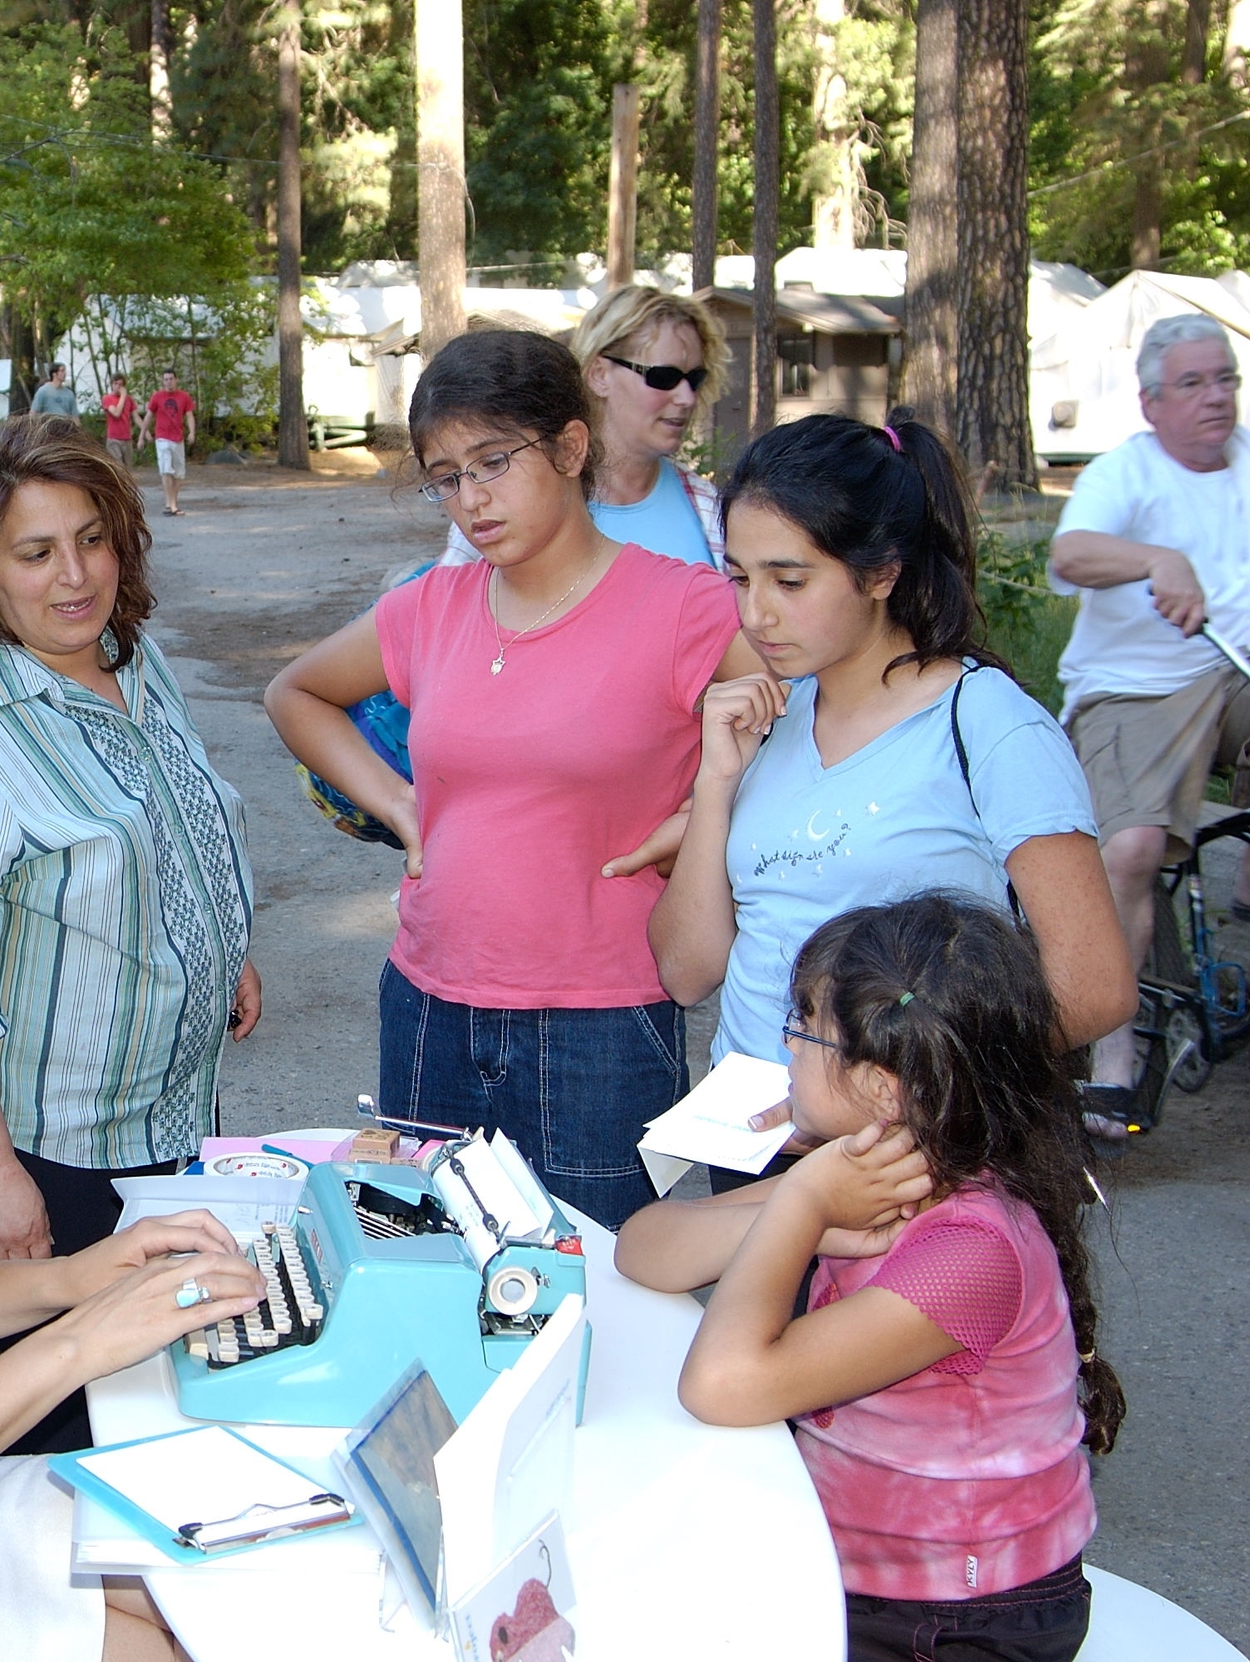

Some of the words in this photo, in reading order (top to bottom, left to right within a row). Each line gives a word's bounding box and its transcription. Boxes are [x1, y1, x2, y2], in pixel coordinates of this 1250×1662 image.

[753, 850, 780, 877] What
[781, 849, 804, 867] sign
[967, 1558, 975, 1584] KYLY
